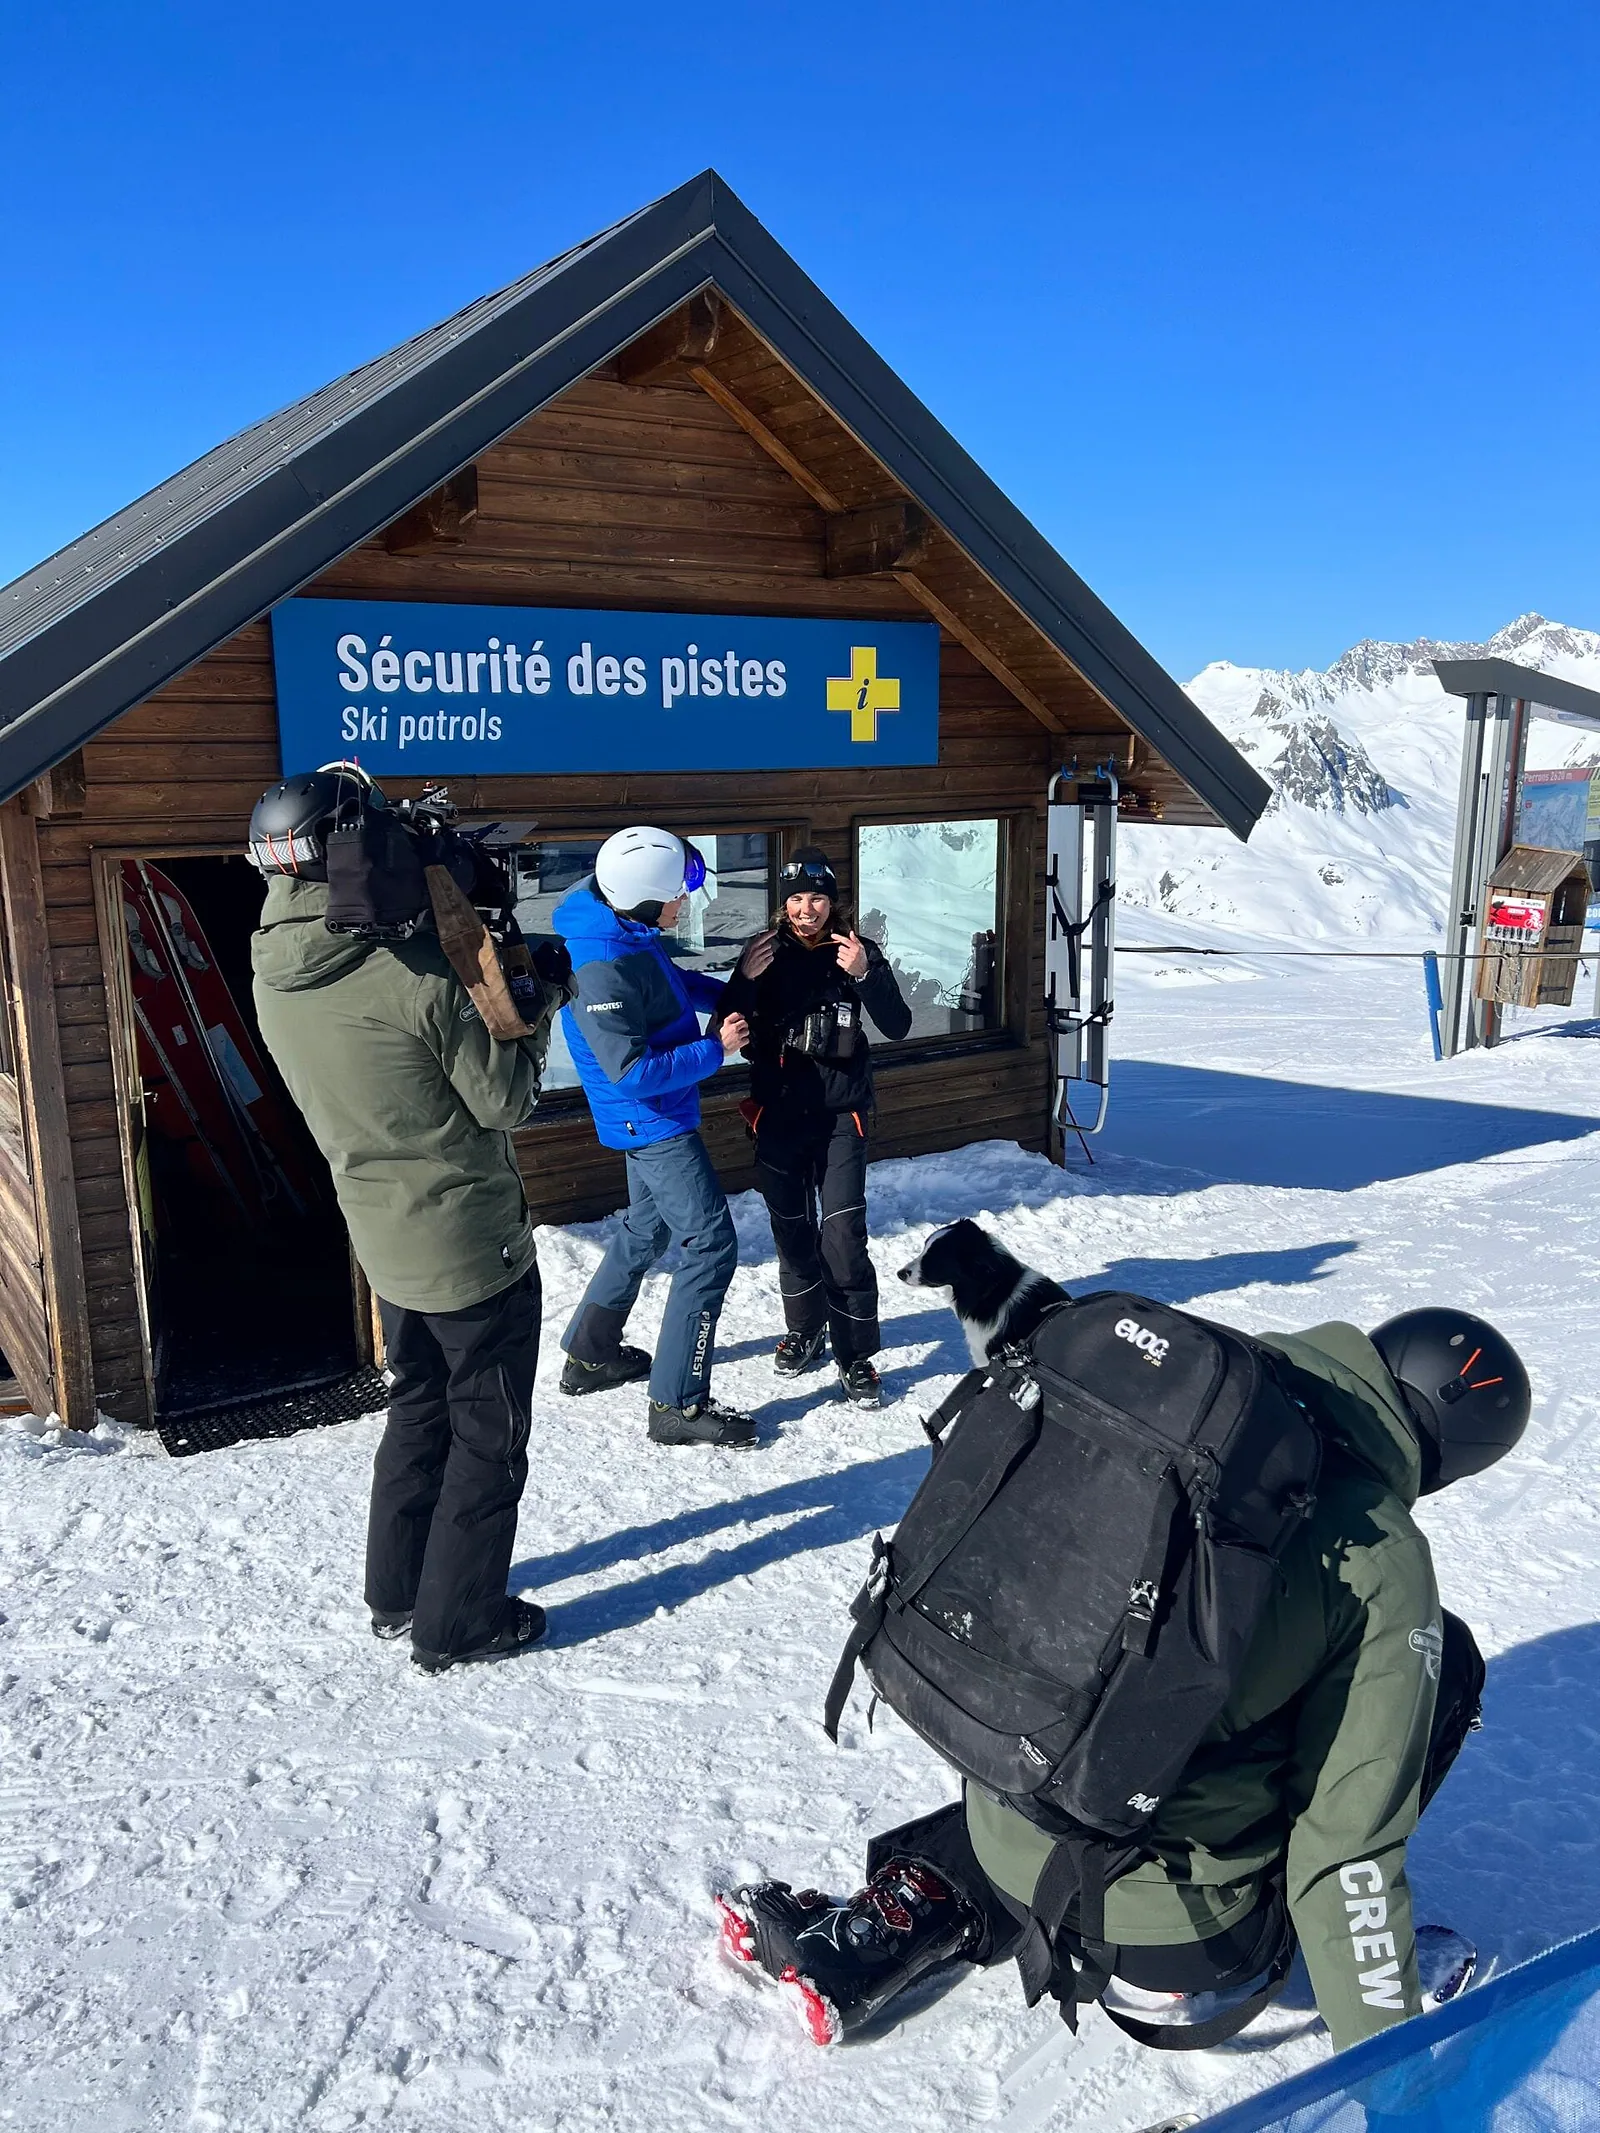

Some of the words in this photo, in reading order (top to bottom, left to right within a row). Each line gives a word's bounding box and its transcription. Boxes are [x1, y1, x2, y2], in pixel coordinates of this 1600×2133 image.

[336, 634, 551, 695] Sécurité
[567, 642, 647, 696] des
[662, 643, 788, 709] pistes
[856, 678, 869, 710] i
[341, 706, 388, 742] Ski
[398, 707, 502, 750] patrols
[592, 1001, 623, 1012] PROTEST
[692, 1322, 711, 1378] PROTEST
[1114, 1318, 1170, 1360] evoc
[1339, 1860, 1405, 2010] CREW
